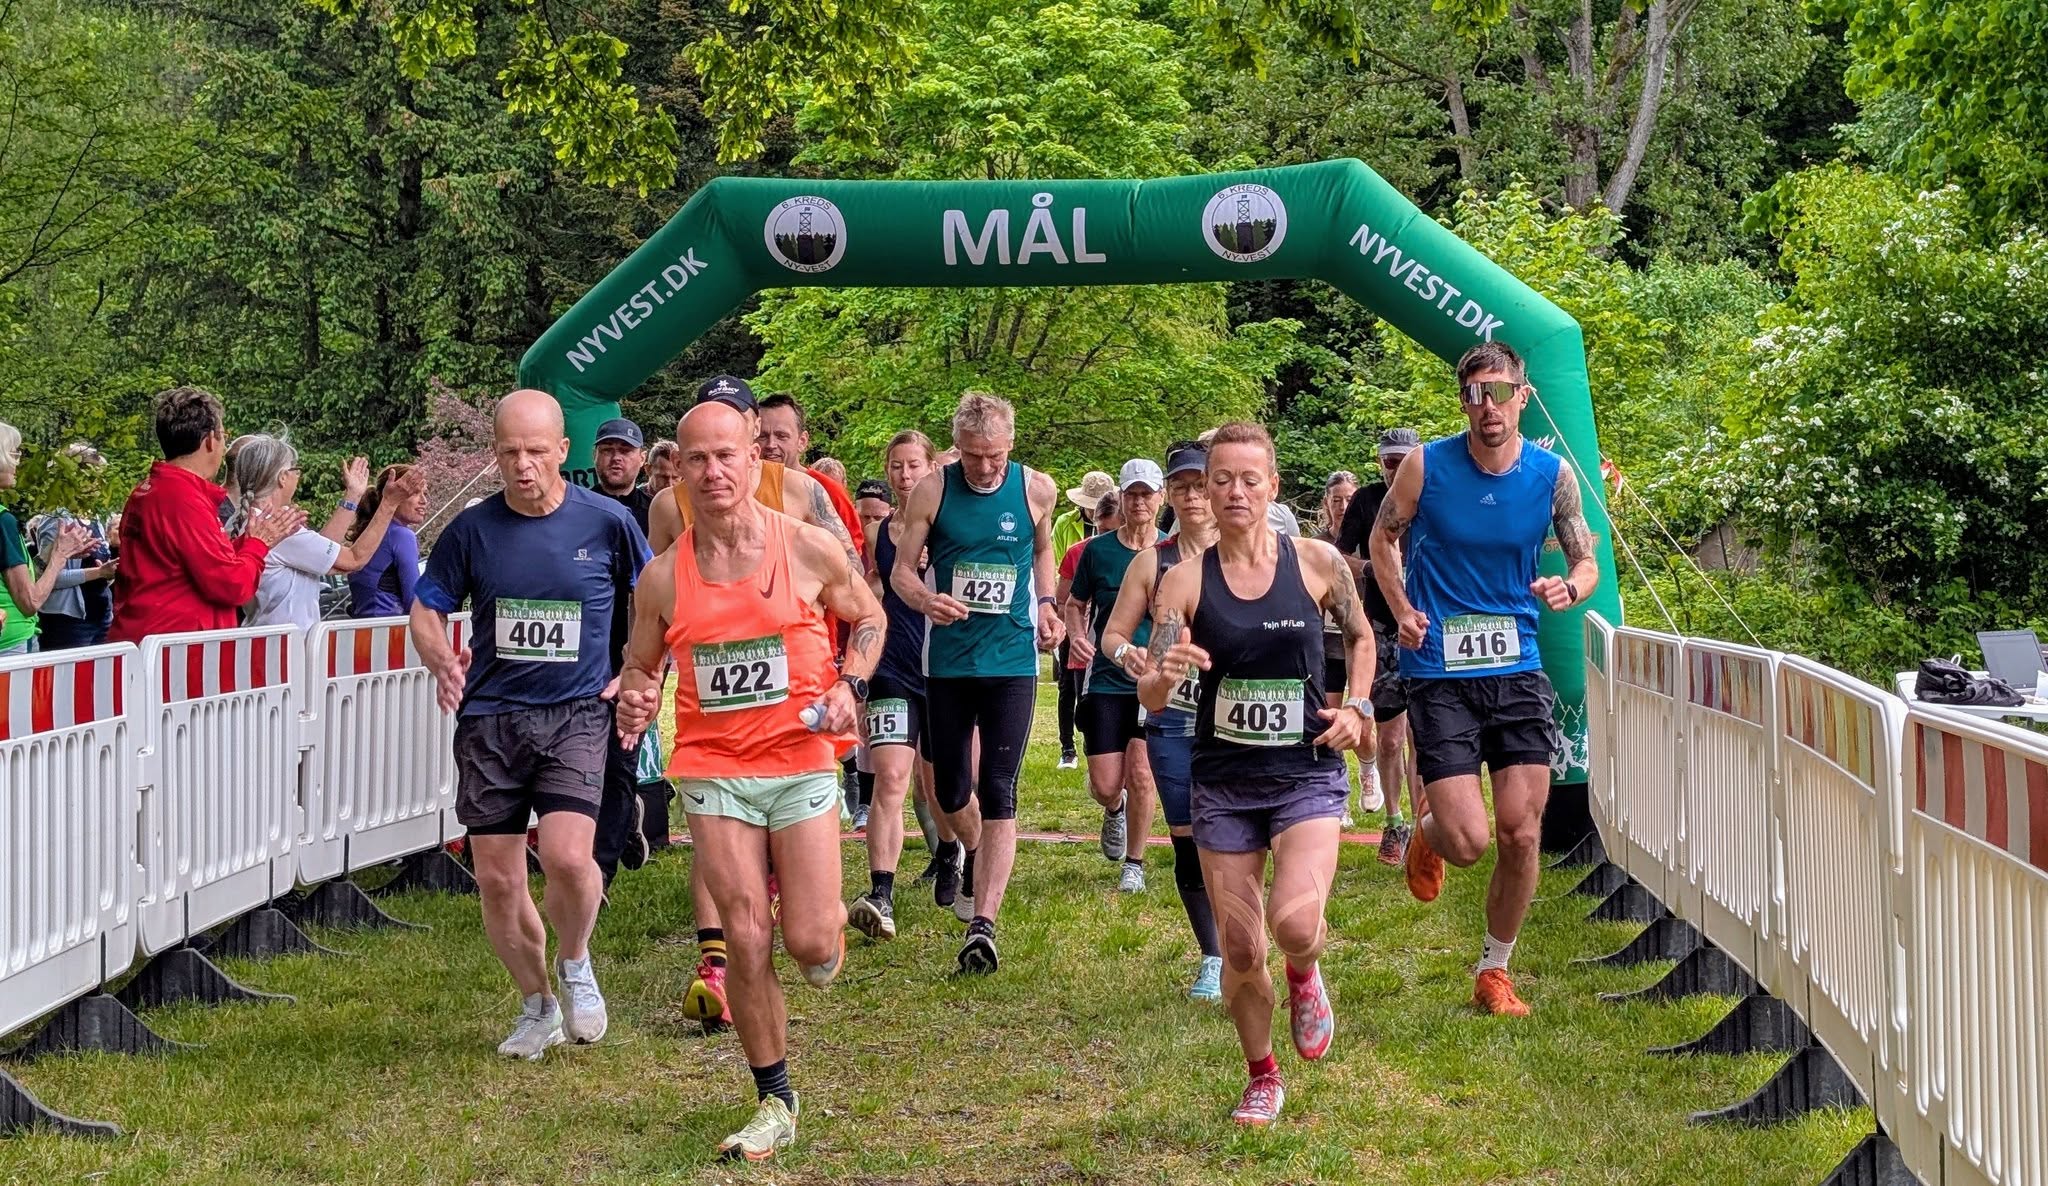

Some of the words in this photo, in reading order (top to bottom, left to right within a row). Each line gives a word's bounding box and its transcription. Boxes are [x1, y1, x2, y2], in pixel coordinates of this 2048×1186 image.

[794, 196, 832, 210] KREDS
[1230, 184, 1269, 196] KREDS
[943, 192, 1107, 266] MÅL
[783, 259, 832, 273] NY-VEST
[1221, 246, 1272, 262] NY-VEST
[1348, 223, 1505, 344] NYVEST.DK
[565, 246, 709, 373] NYVEST.DK
[962, 580, 1006, 604] 423
[509, 621, 565, 649] 404
[1458, 631, 1507, 658] 416
[710, 661, 774, 697] 422
[1227, 702, 1287, 732] 403
